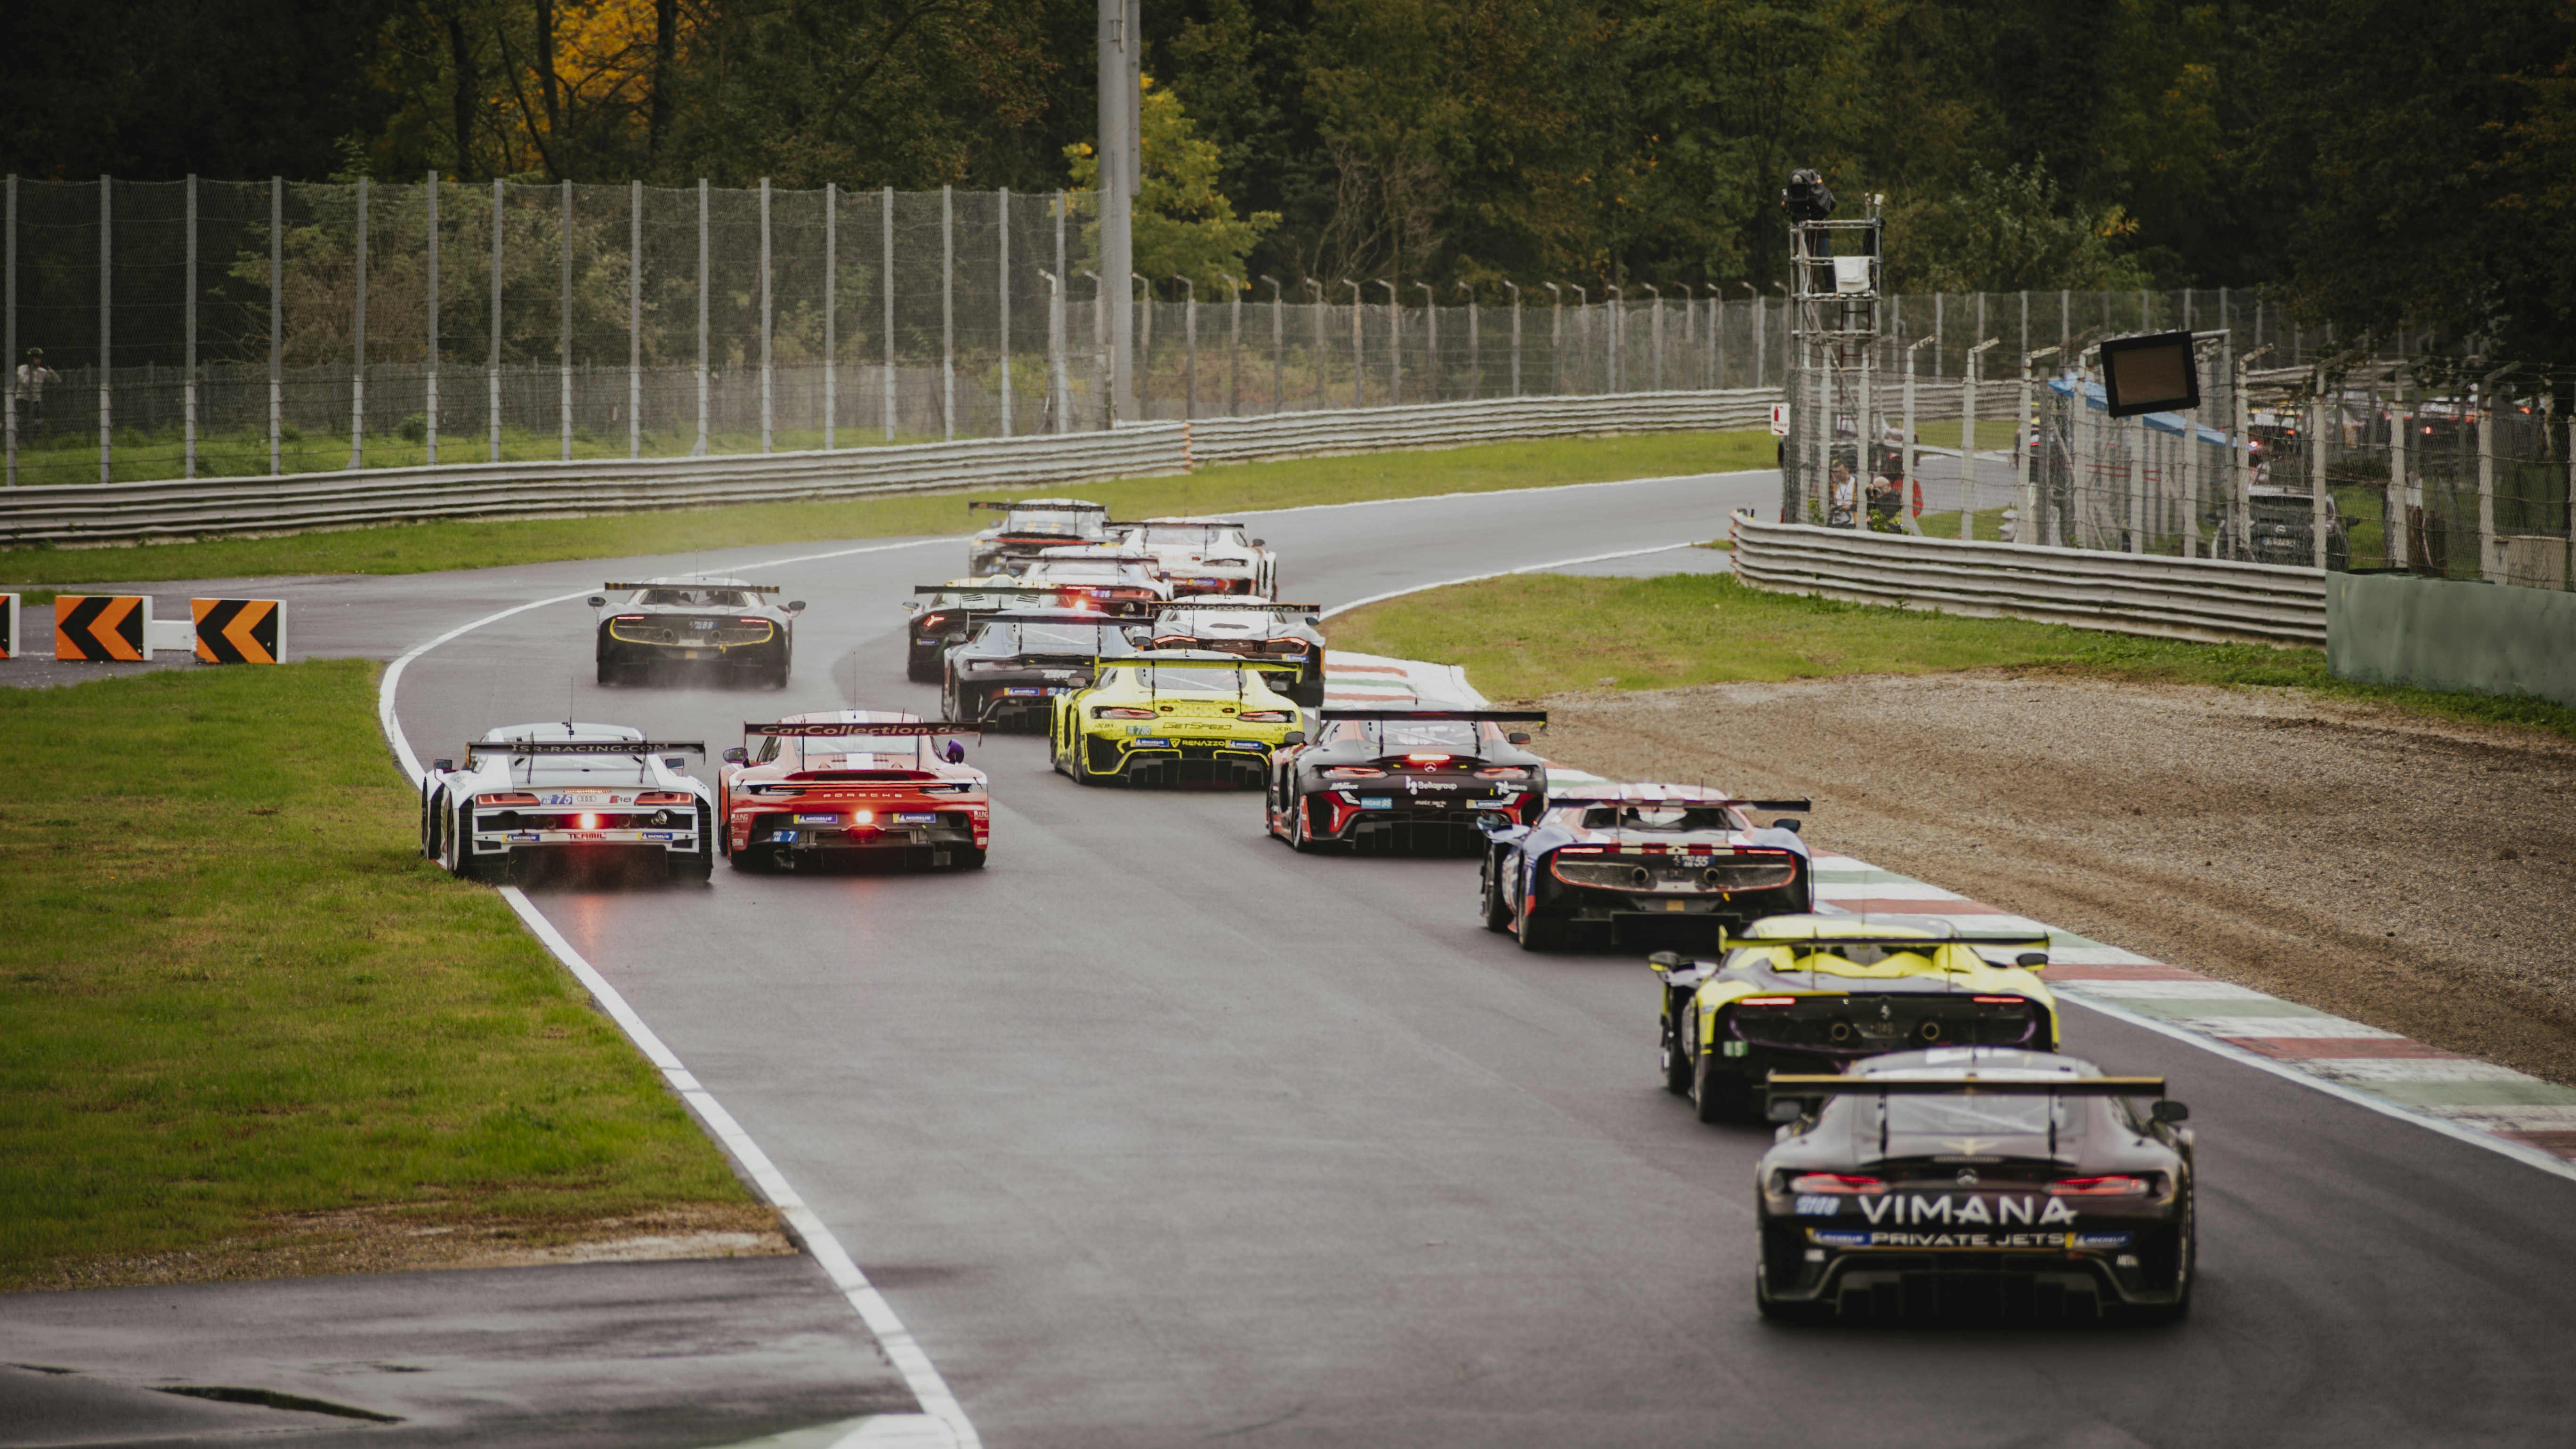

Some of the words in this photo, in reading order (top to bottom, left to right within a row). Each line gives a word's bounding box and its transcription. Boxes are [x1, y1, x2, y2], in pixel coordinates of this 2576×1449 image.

[702, 621, 713, 629] 88
[760, 724, 965, 735] CarCollection.de
[1136, 726, 1151, 735] 786
[511, 743, 669, 753] ISR-RACING.COM
[1418, 781, 1457, 791] Bellagroup
[556, 795, 572, 804] 75
[788, 831, 796, 842] 7
[1694, 855, 1709, 868] 55
[1857, 1194, 2079, 1225] VIMANA
[1871, 1232, 1990, 1246] PRIVATE
[1996, 1232, 2066, 1246] JETS
